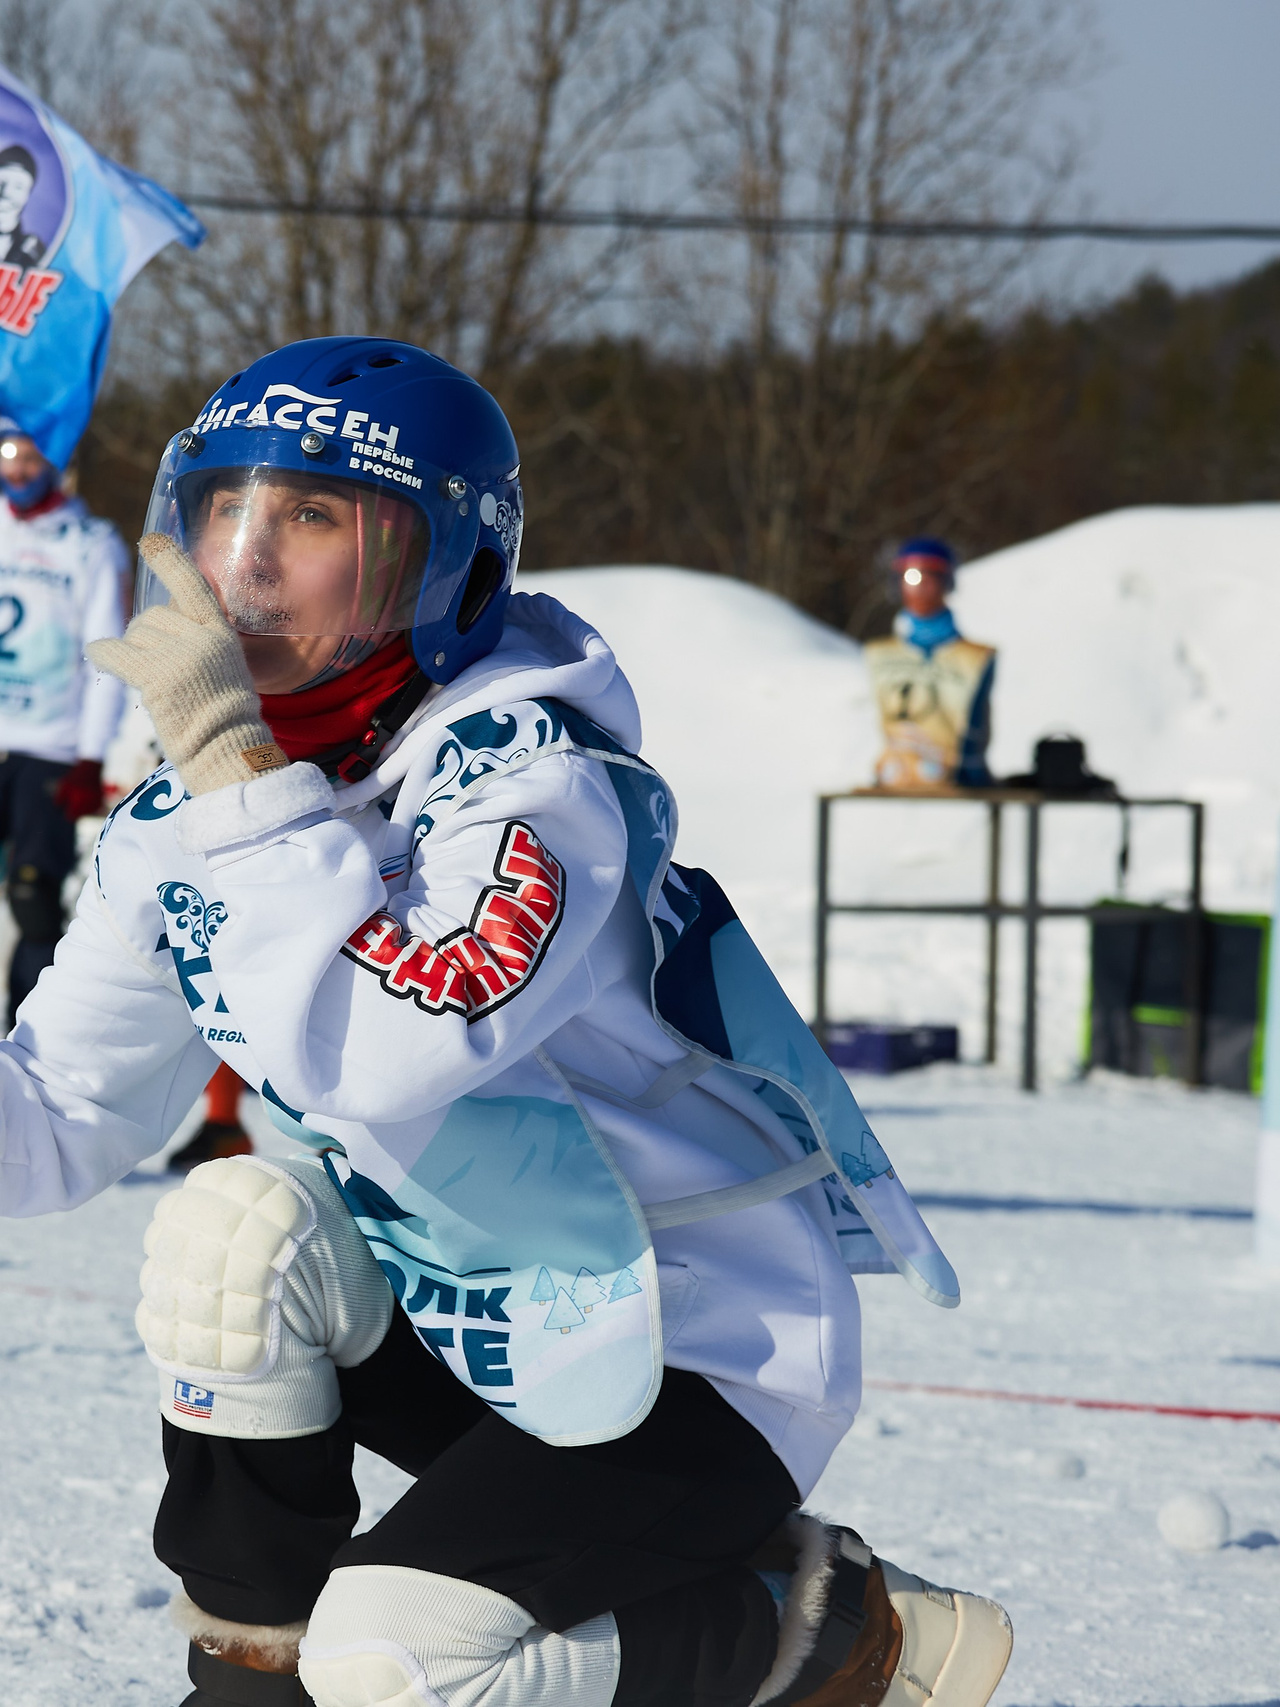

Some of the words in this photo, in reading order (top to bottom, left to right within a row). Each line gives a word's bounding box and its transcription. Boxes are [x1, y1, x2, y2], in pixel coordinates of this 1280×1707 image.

[351, 441, 414, 470] ПЕРВЫЕ
[349, 456, 361, 469] В
[362, 460, 423, 490] РОССИИ
[175, 1382, 208, 1404] LP
